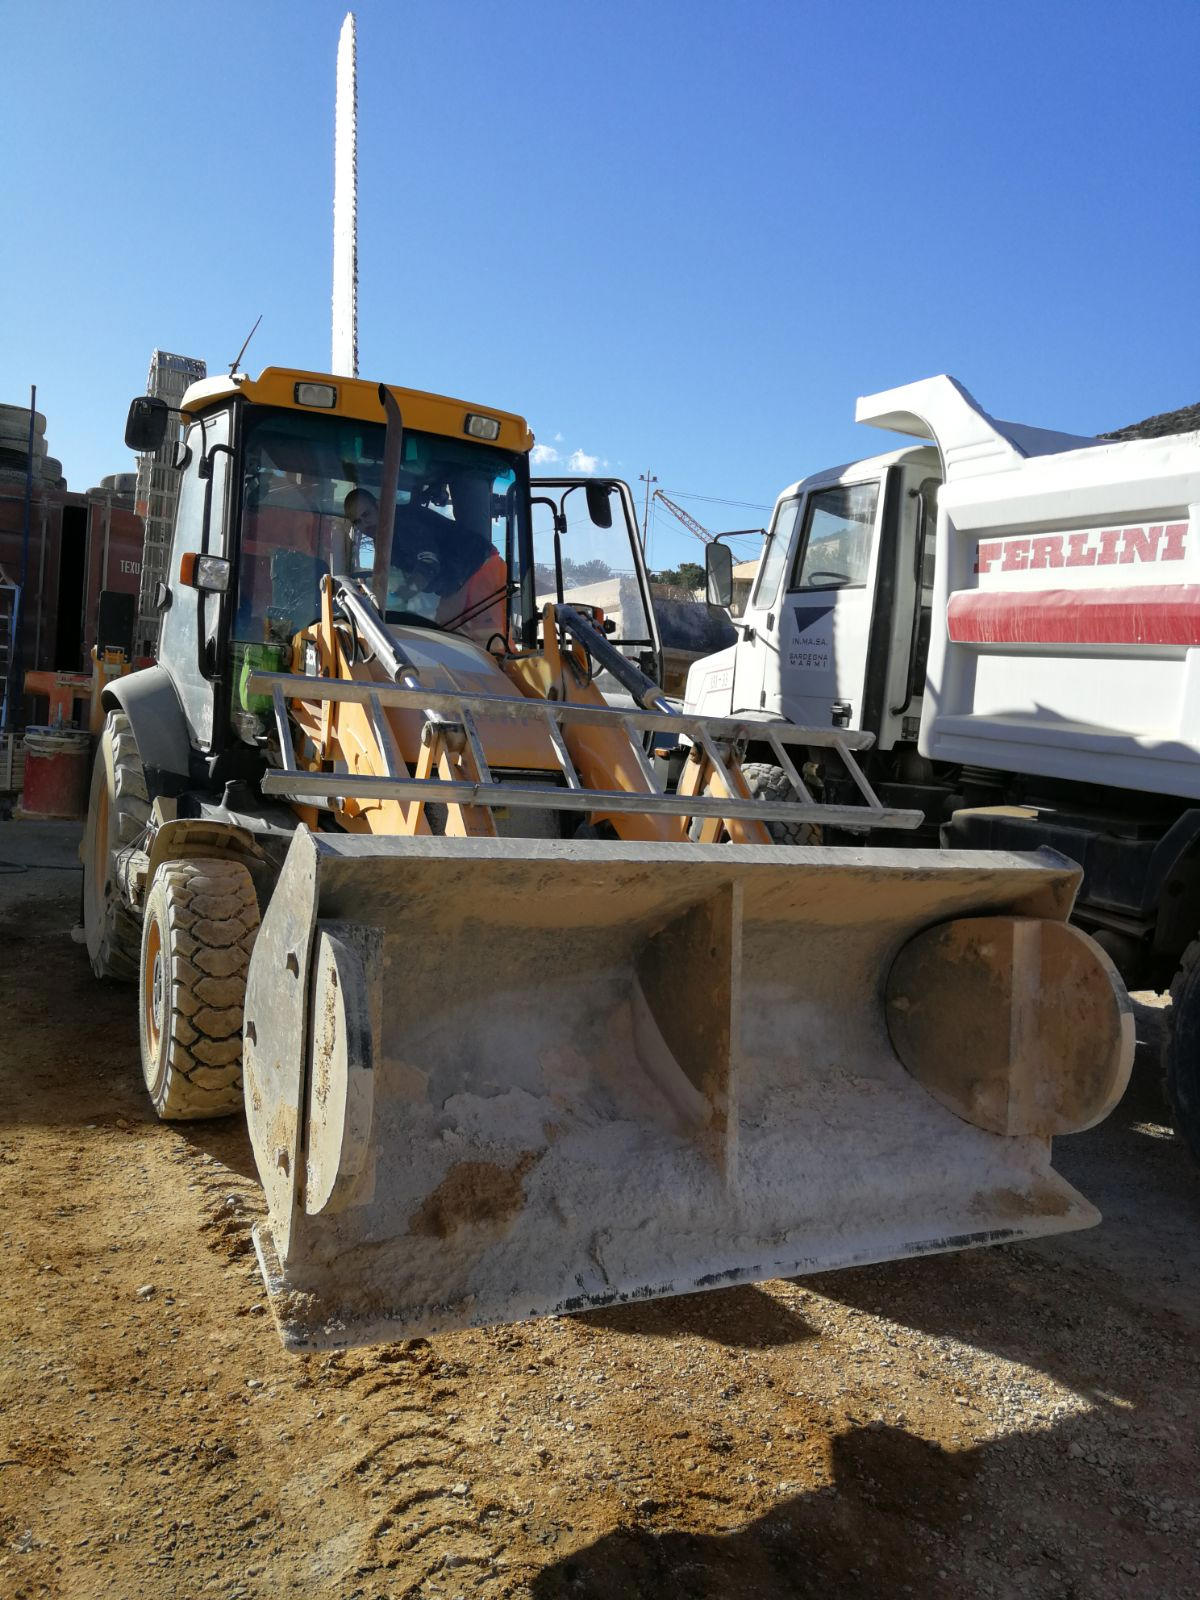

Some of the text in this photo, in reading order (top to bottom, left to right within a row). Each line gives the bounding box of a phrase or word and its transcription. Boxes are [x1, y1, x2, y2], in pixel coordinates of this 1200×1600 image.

[974, 523, 1189, 574] PERLINI
[120, 560, 140, 575] TEXU
[789, 652, 828, 661] SARDEGNA
[790, 660, 826, 668] MARMI
